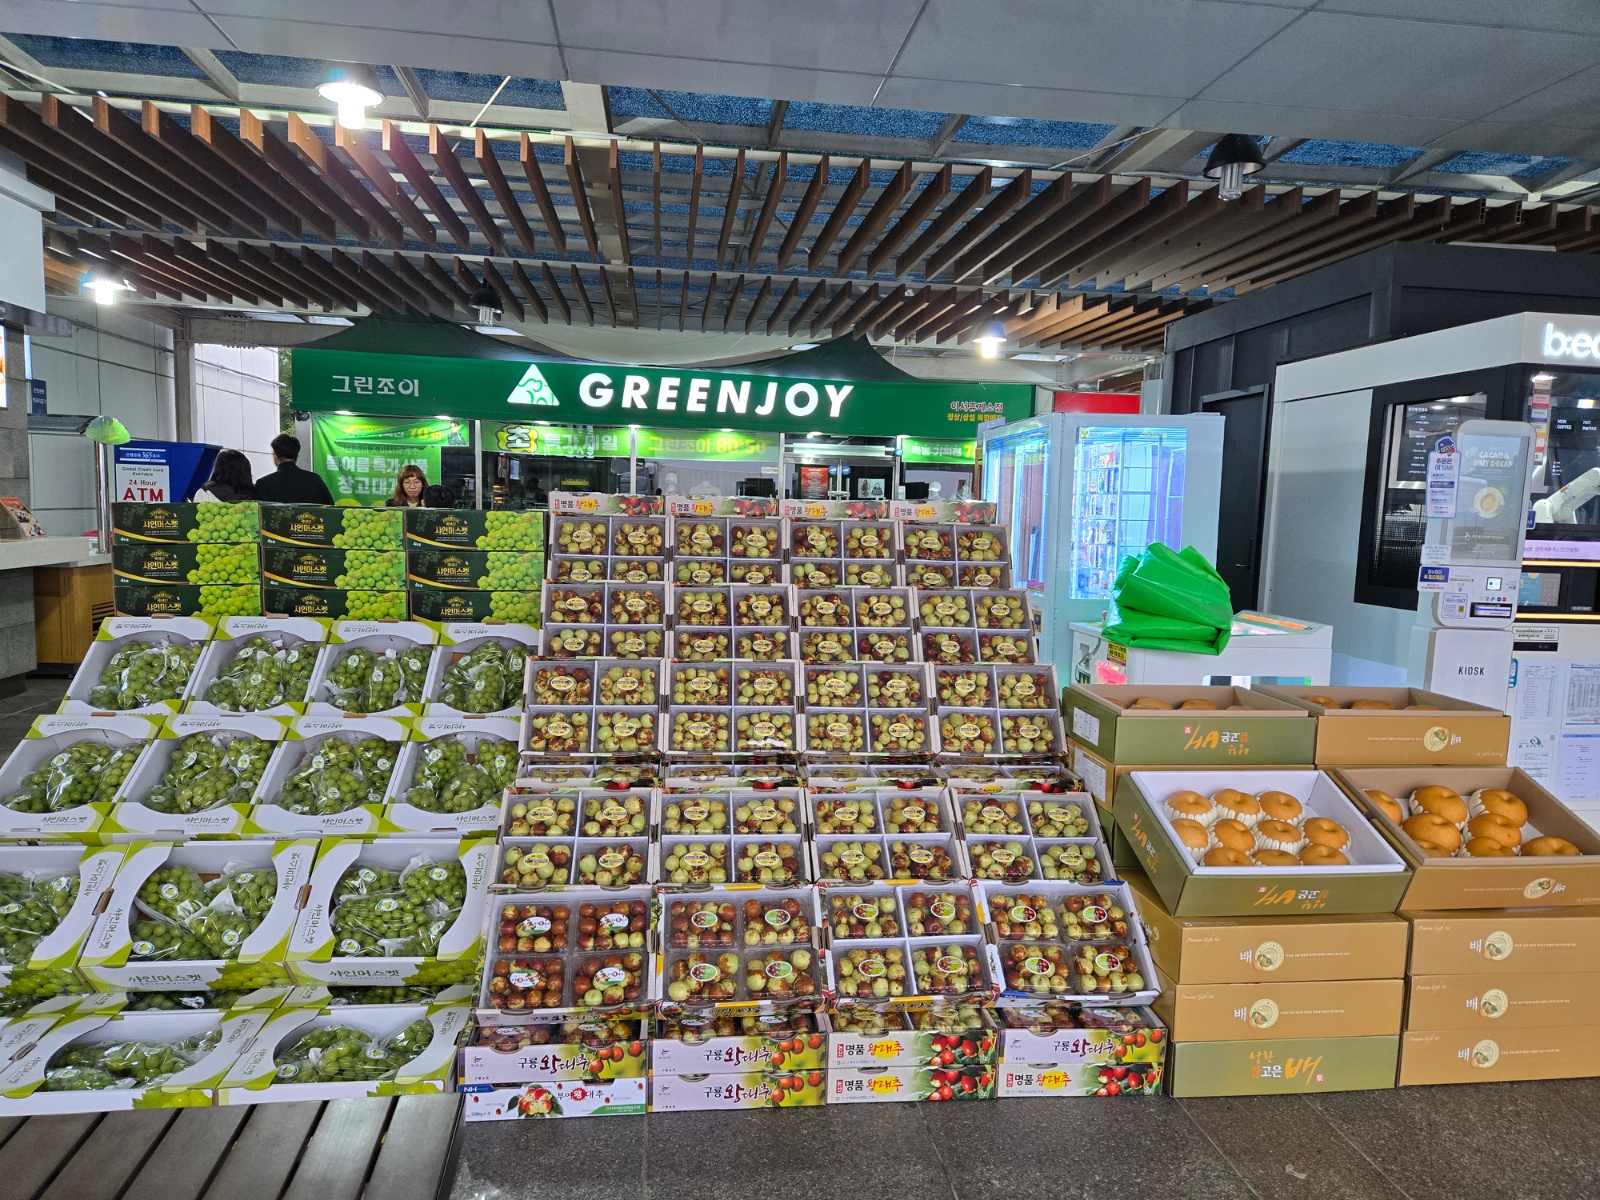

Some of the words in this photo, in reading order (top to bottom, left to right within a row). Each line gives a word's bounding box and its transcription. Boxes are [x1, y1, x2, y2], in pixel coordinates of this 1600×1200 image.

[331, 375, 419, 397] 그린조이
[579, 372, 854, 418] GREENJOY
[951, 401, 1004, 413] 이서휴게소점
[506, 426, 531, 448] 초
[649, 436, 710, 453] 그린조이
[122, 487, 164, 502] ATM
[560, 499, 574, 509] 명품
[676, 503, 690, 512] 명품
[790, 506, 803, 516] 명품
[900, 508, 913, 517] 명품
[143, 520, 179, 529] 샤인머스켓
[290, 524, 325, 533] 샤인머스켓
[435, 526, 469, 535] 샤인머스켓
[143, 561, 179, 570] 샤인머스켓
[292, 565, 327, 574] 샤인머스켓
[436, 567, 470, 576] 샤인머스켓
[146, 603, 182, 612] 샤인머스켓
[293, 605, 329, 614] 샤인머스켓
[440, 608, 474, 616] 샤인머스켓
[1458, 666, 1485, 676] KIOSK
[1450, 733, 1462, 746] 배
[40, 816, 88, 824] 샤인머스켓
[184, 816, 230, 824] 샤인머스켓
[320, 818, 364, 826] 샤인머스켓
[454, 814, 497, 823] 샤인머스켓
[83, 858, 109, 898] 샤인머스켓
[282, 852, 302, 890] 샤인머스켓
[472, 852, 487, 890] 샤인머스켓
[1552, 882, 1566, 893] 배
[99, 907, 124, 950] 샤인머스켓
[303, 904, 323, 945] 샤인머스켓
[1469, 938, 1482, 953] 배
[1239, 949, 1252, 964] 배
[127, 973, 203, 983] 샤인머스켓
[328, 969, 400, 977] 샤인머스켓
[1465, 997, 1478, 1011] 배
[1234, 1007, 1247, 1022] 배
[226, 1017, 253, 1044] 샤인머스켓
[440, 1010, 458, 1036] 샤인머스켓
[845, 1044, 865, 1056] 명품
[867, 1040, 905, 1058] 왕대추
[1052, 1040, 1070, 1052] 구룡
[1071, 1038, 1116, 1058] 왕대추
[1457, 1047, 1470, 1062] 배
[241, 1047, 268, 1076] 샤인머스켓
[517, 1056, 539, 1070] 구룡
[539, 1053, 591, 1075] 왕대추
[703, 1049, 723, 1062] 구룡
[723, 1046, 773, 1067] 왕대추
[1249, 1050, 1274, 1065] 성환
[1284, 1055, 1323, 1087] 배
[844, 1080, 864, 1092] 명품
[866, 1076, 904, 1093] 왕대추
[1014, 1073, 1034, 1086] 명품
[1035, 1072, 1072, 1088] 왕대추
[703, 1086, 723, 1099] 구룡
[723, 1083, 773, 1104] 왕대추
